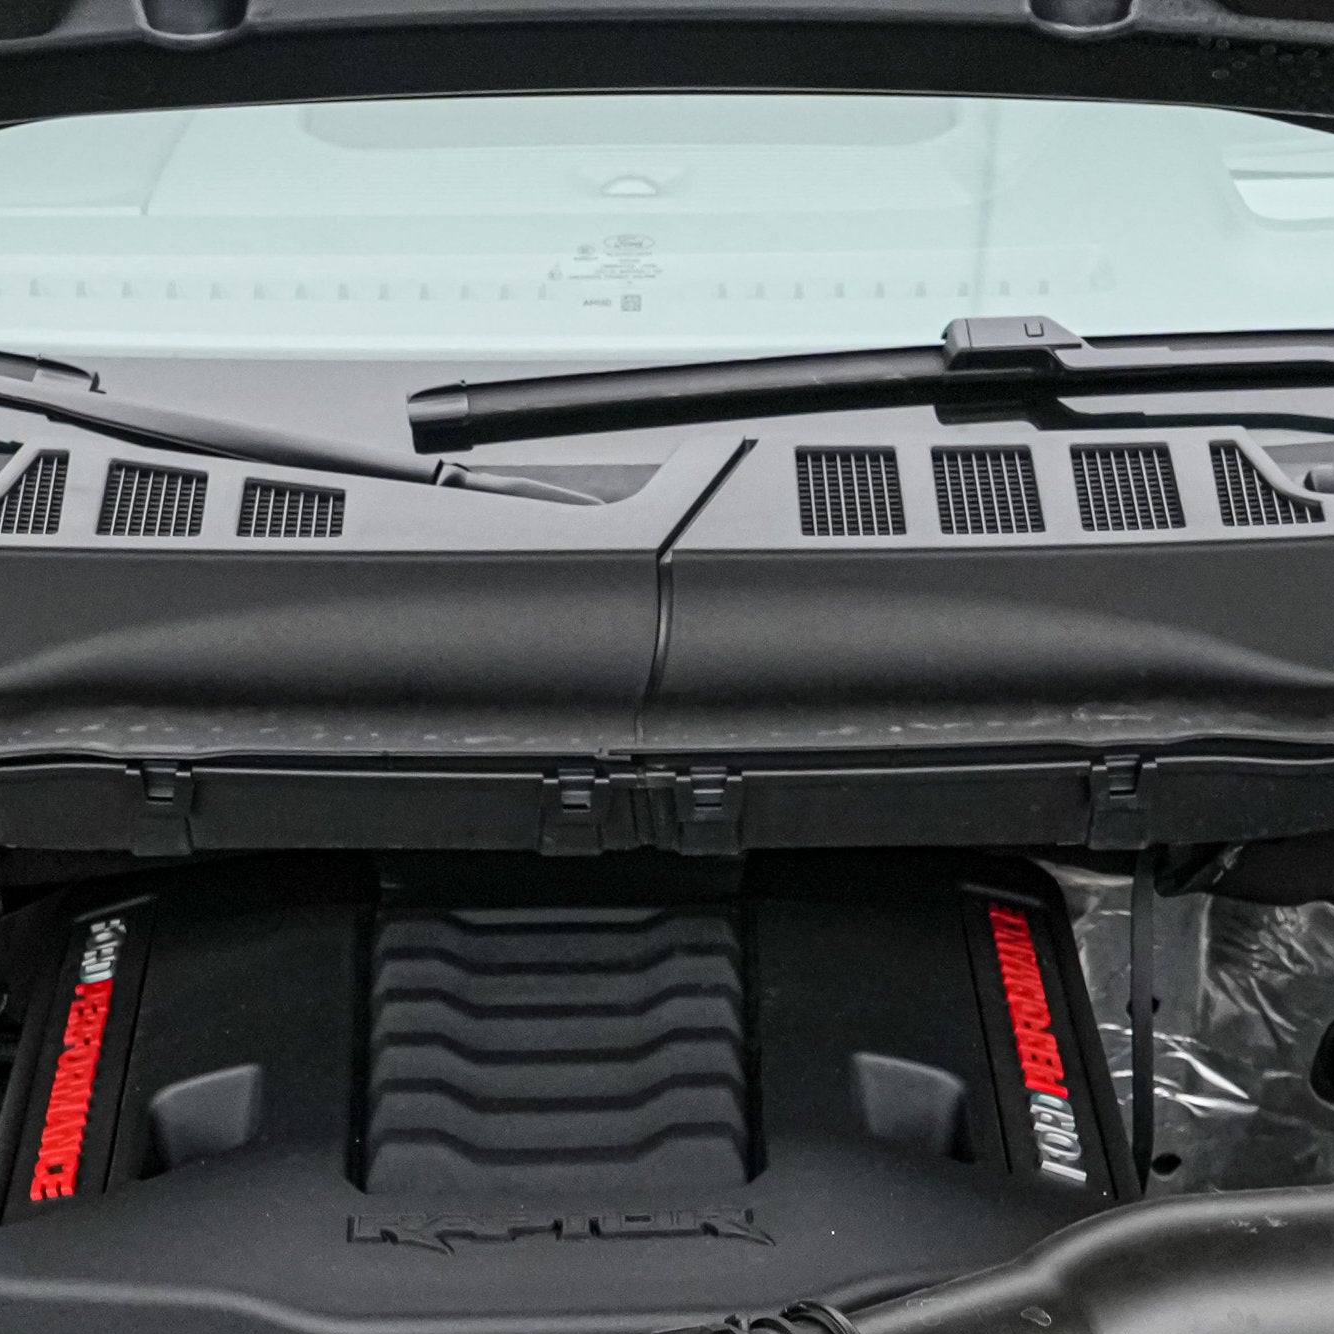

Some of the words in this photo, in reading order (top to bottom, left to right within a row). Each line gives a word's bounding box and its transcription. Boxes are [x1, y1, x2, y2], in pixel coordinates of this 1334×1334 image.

[78, 919, 127, 984] FORD
[989, 905, 1069, 1099] PERFORMANCE
[30, 978, 115, 1201] PERFORMANCE
[1029, 1093, 1088, 1182] FORD
[347, 1213, 776, 1256] RAPTOR
